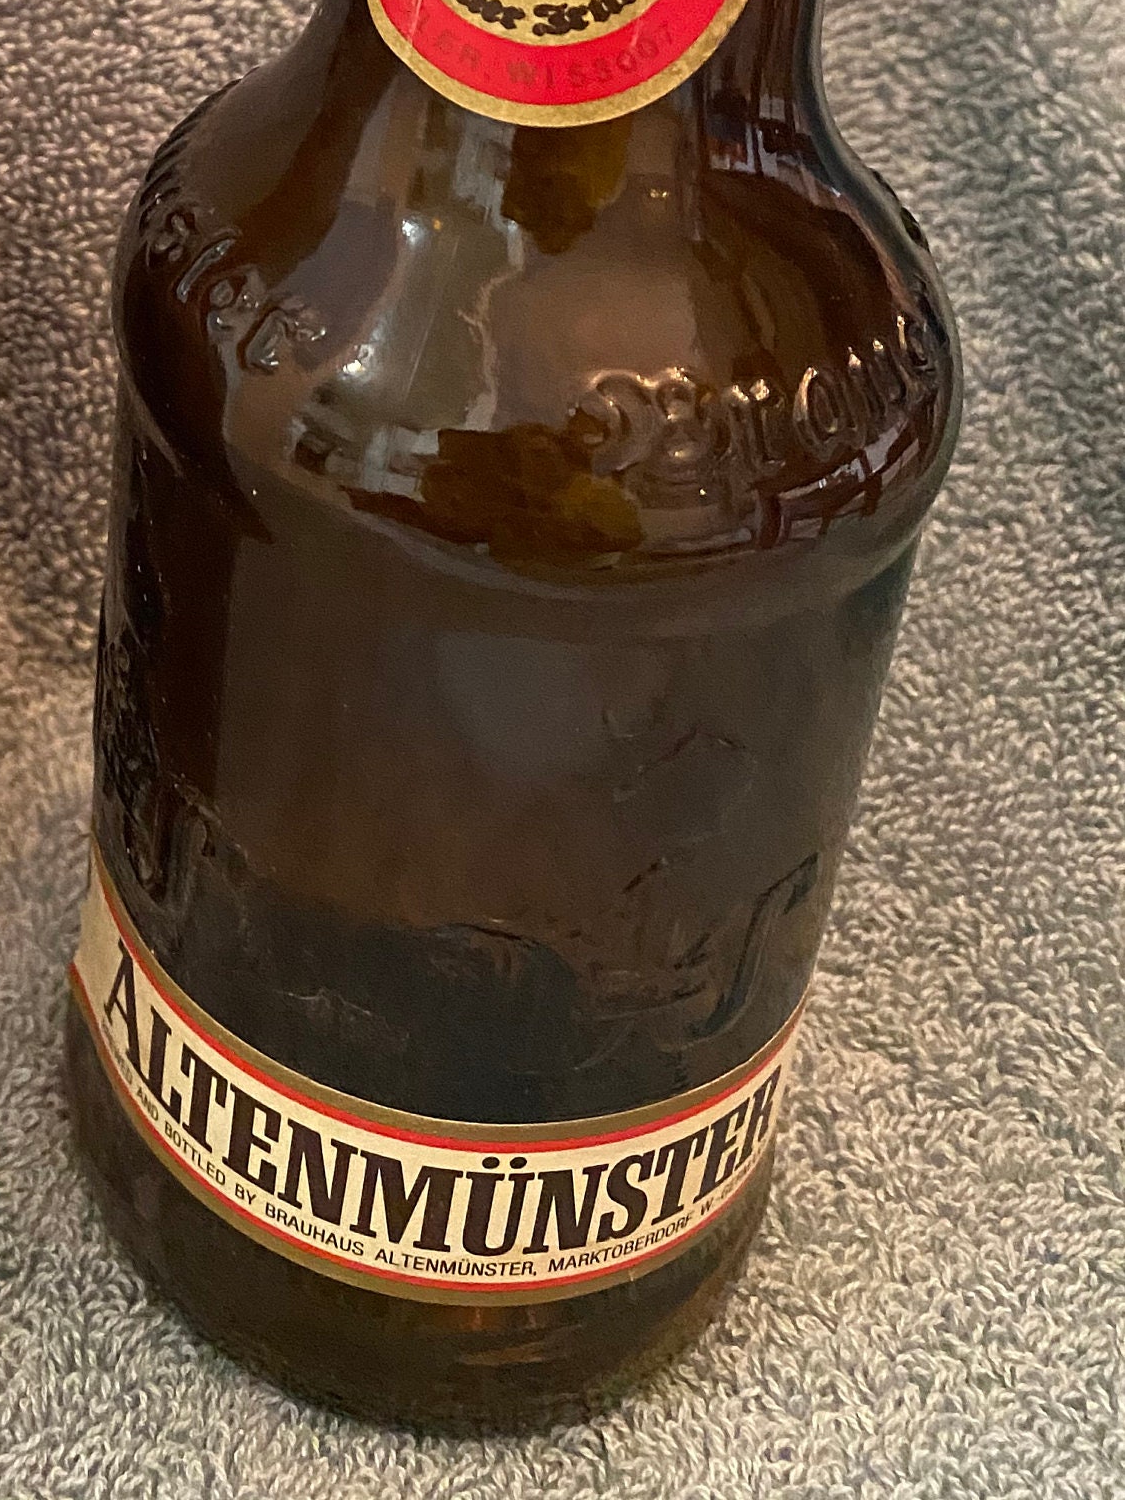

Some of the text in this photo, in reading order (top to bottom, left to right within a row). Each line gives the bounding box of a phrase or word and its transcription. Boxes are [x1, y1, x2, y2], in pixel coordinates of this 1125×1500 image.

[103, 939, 782, 1258] ALTENMÜNSTER
[136, 1086, 160, 1122] AND
[164, 1121, 226, 1186] BOTTLED
[234, 1183, 257, 1205] BY
[264, 1202, 365, 1257] BRAUHAUS
[374, 1248, 538, 1277] ALTENMÜNSTER,
[547, 1214, 693, 1273] MARKTOBERDORF
